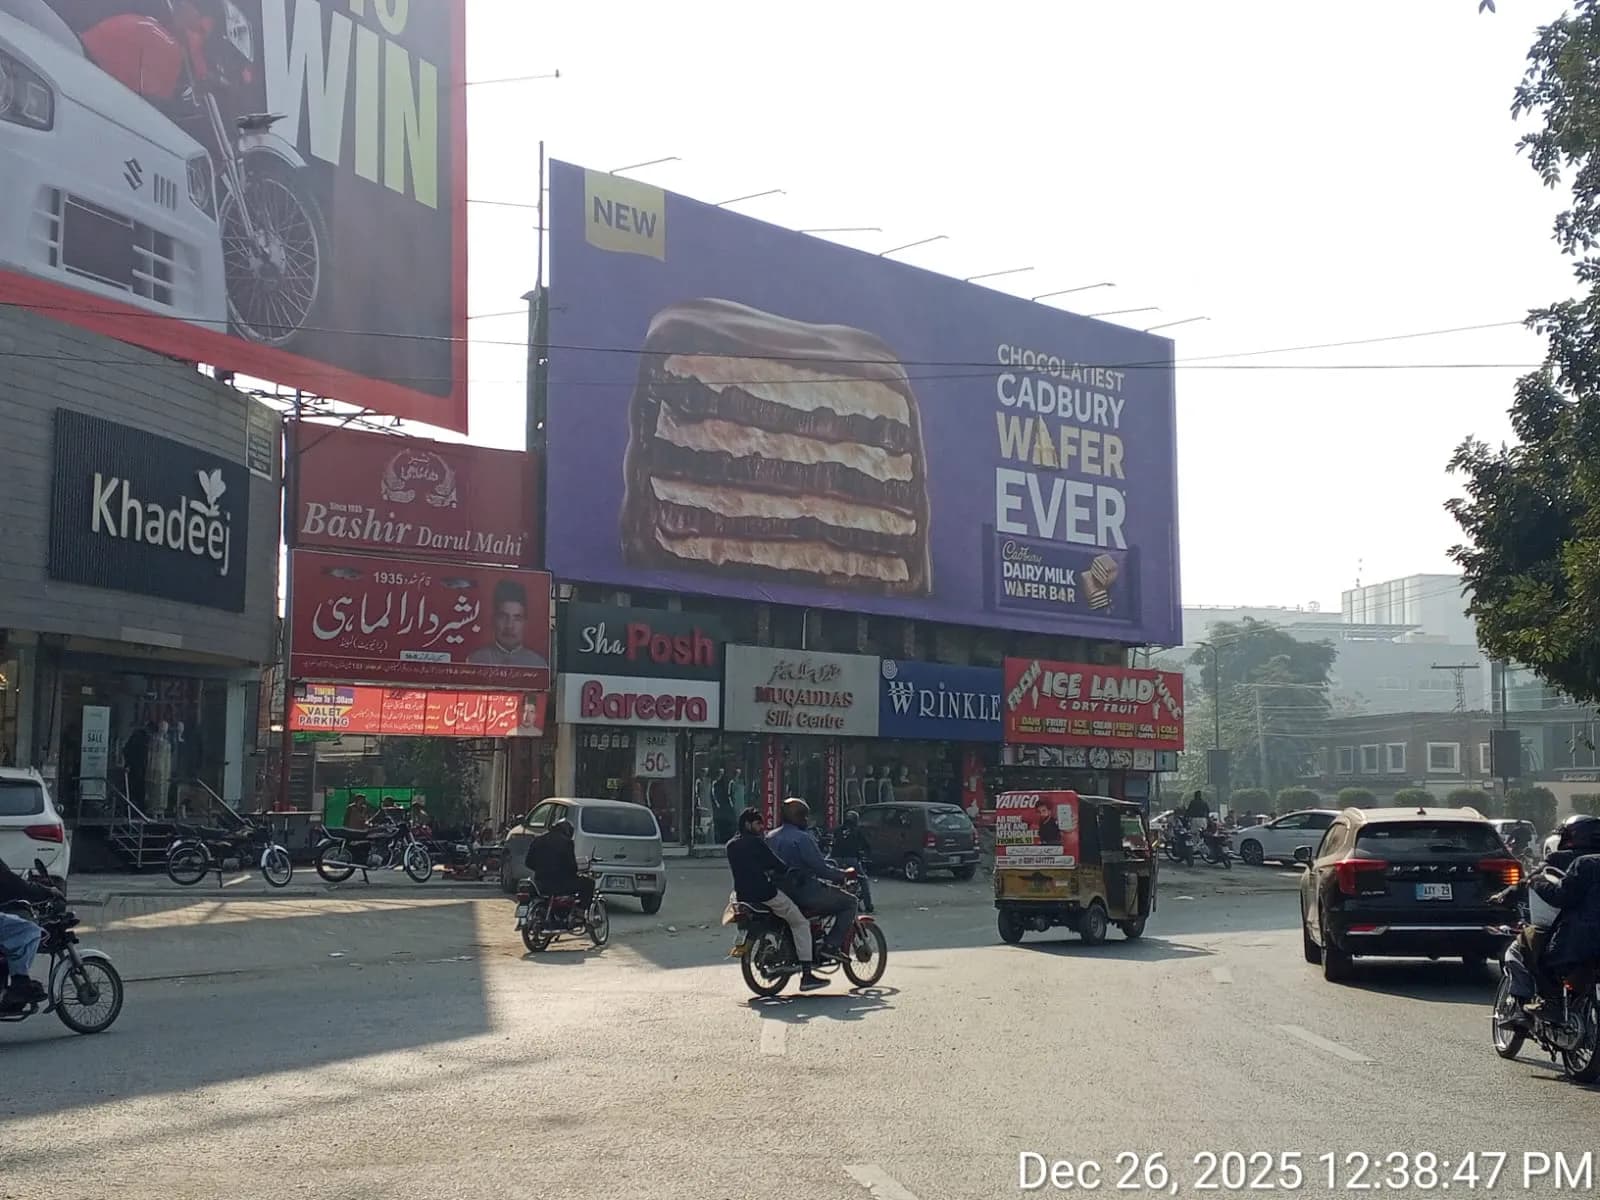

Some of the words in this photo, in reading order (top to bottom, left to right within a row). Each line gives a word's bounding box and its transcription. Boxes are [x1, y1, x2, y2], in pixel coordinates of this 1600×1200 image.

[262, 0, 438, 209] WIN
[593, 195, 657, 239] NEW
[997, 343, 1125, 393] CHOCOLATIEST
[996, 373, 1125, 429] CADBURY
[996, 410, 1125, 480] WAFER
[92, 472, 231, 576] Khadeej
[996, 467, 1128, 550] EVER
[301, 502, 412, 544] Bashir
[416, 526, 471, 551] Darul
[474, 532, 521, 556] Mahi
[373, 571, 404, 585] 1935
[1003, 561, 1044, 581] DAIRY
[1044, 566, 1077, 586] MILK
[1049, 586, 1076, 603] BAR
[625, 623, 716, 666] Posh
[580, 680, 708, 722] Bareera
[755, 686, 853, 708] MUQADDAS
[1040, 671, 1082, 699] ICE
[1088, 674, 1155, 704] LAND
[299, 715, 349, 727] PARKING
[308, 706, 341, 716] VALET
[796, 711, 845, 729] Centre
[1072, 701, 1099, 713] DRY
[1103, 703, 1138, 714] FRUIT
[995, 794, 1040, 809] YANGO
